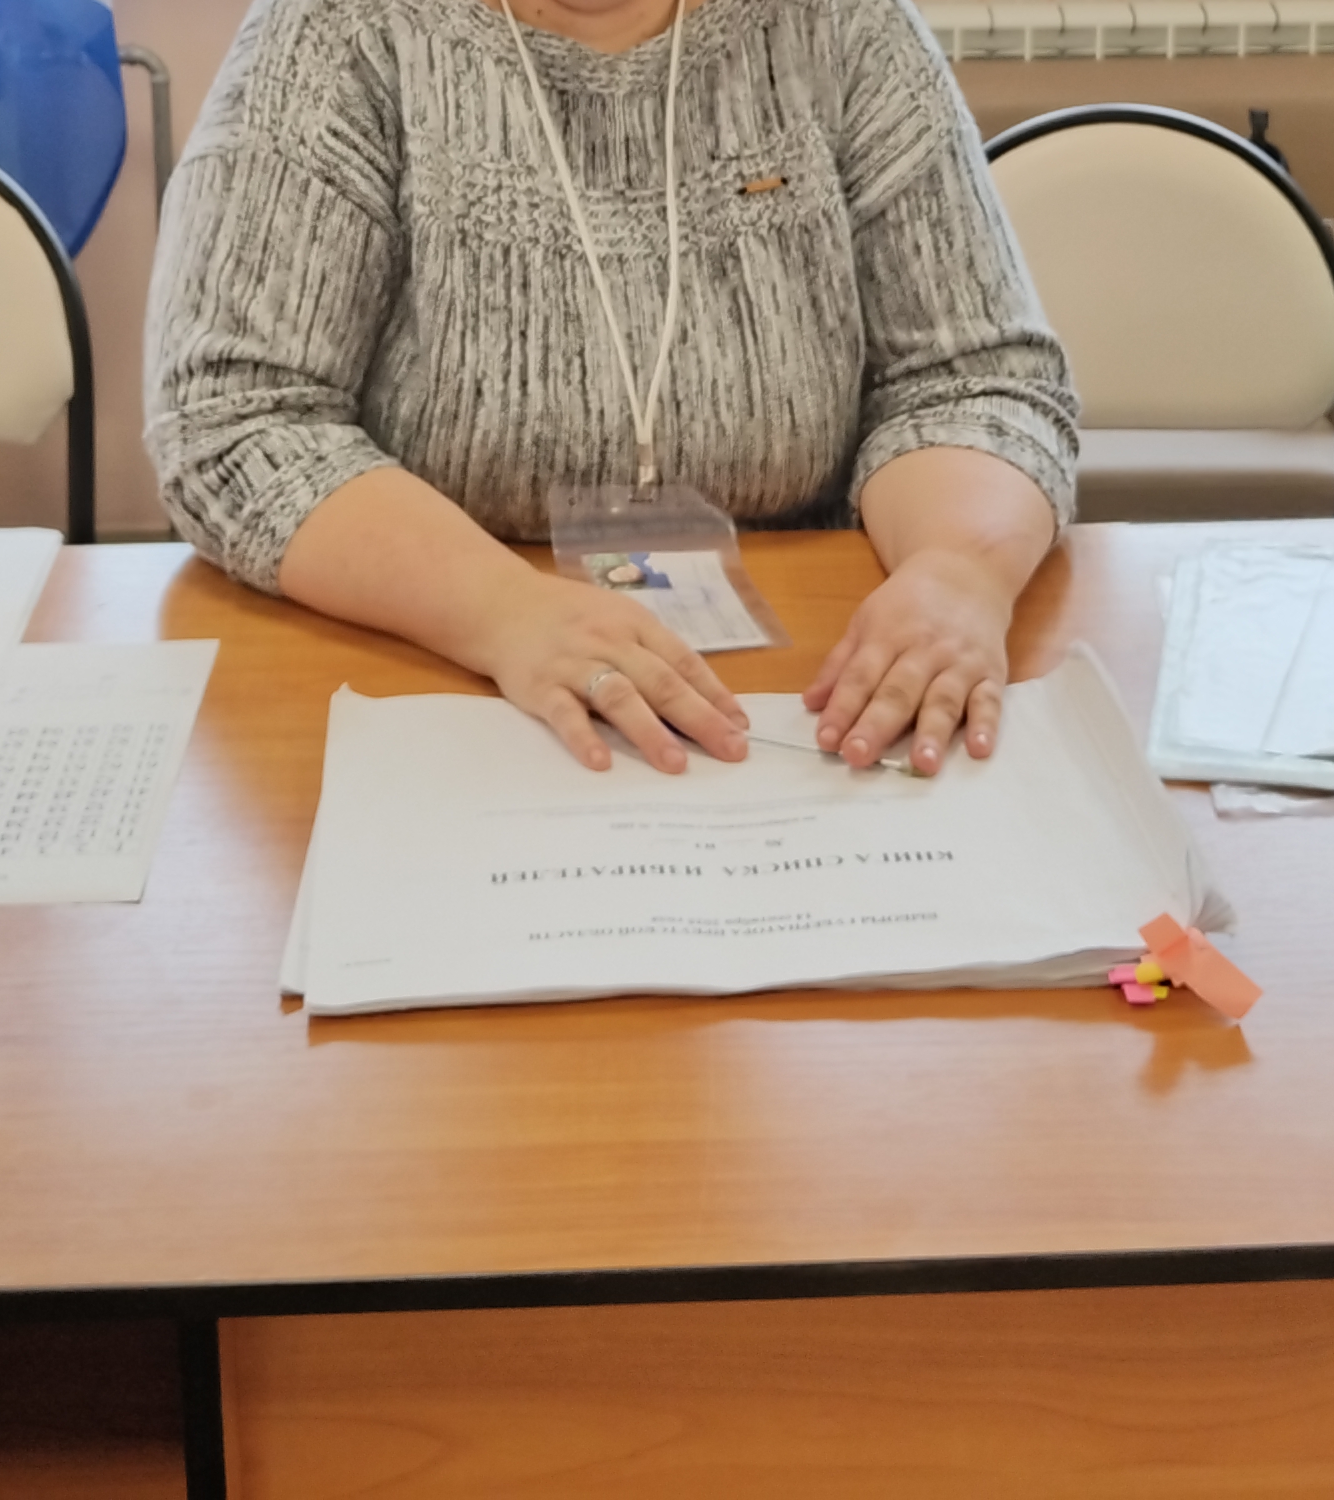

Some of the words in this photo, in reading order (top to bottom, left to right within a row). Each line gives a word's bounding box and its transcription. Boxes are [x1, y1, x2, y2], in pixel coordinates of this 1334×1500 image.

[722, 854, 844, 877] СПИСКА
[855, 850, 954, 864] КНИГА
[491, 864, 702, 886] ИЗБИРАТЕЛЕЙ
